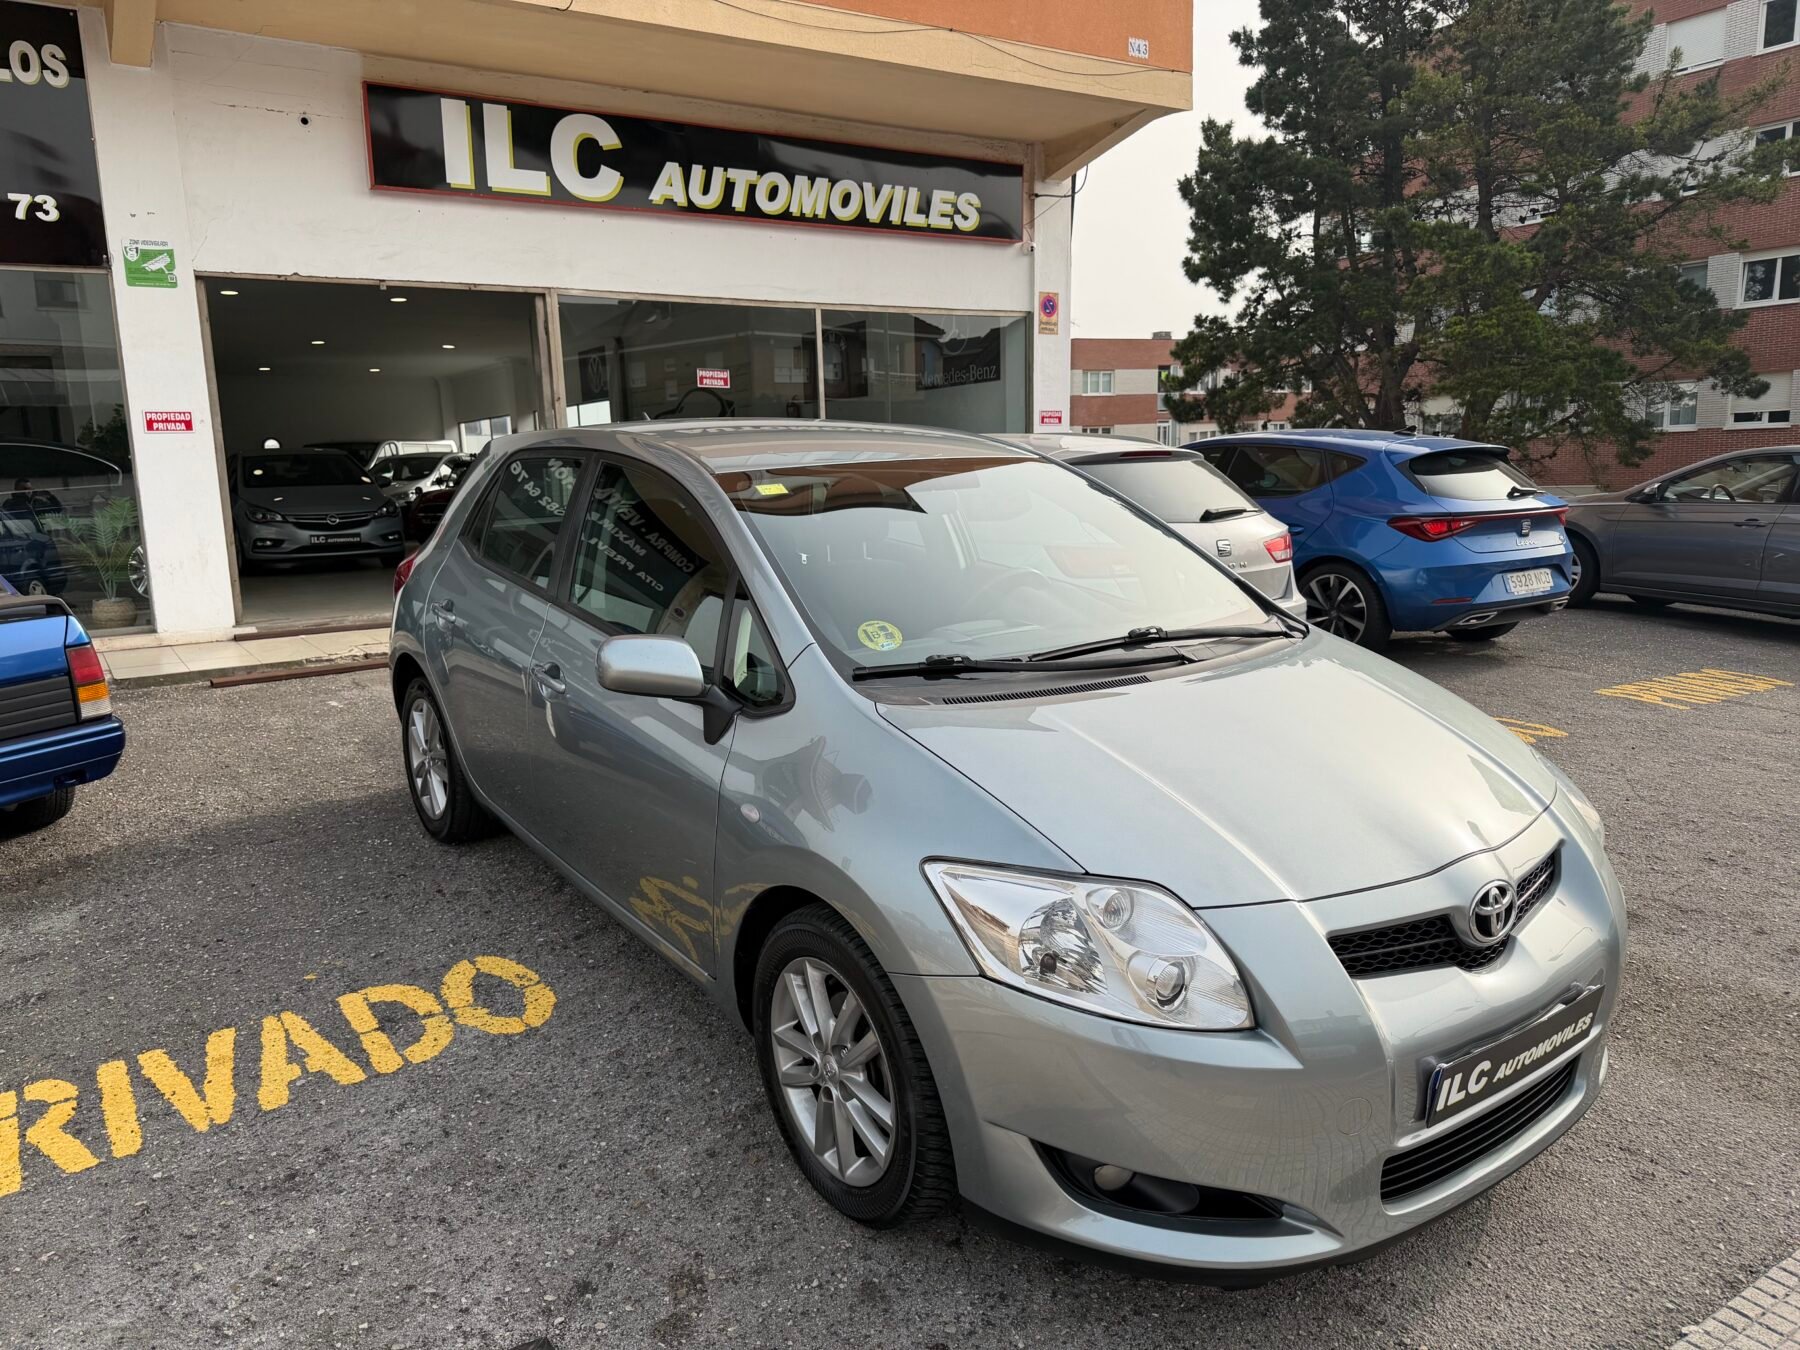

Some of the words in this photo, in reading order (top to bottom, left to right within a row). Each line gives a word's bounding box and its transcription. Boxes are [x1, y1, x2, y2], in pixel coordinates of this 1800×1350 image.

[440, 97, 625, 203] ILC
[648, 161, 982, 232] AUTOMOVILES
[7, 192, 60, 223] 73
[698, 369, 728, 379] PROPIEDAD
[146, 412, 192, 421] PROPIEDAD
[153, 422, 187, 431] PRIVADA
[311, 536, 326, 544] ILC
[1509, 573, 1534, 589] 5928
[1436, 1060, 1492, 1112] ILC
[1492, 1011, 1594, 1083] AUTOMOVILES
